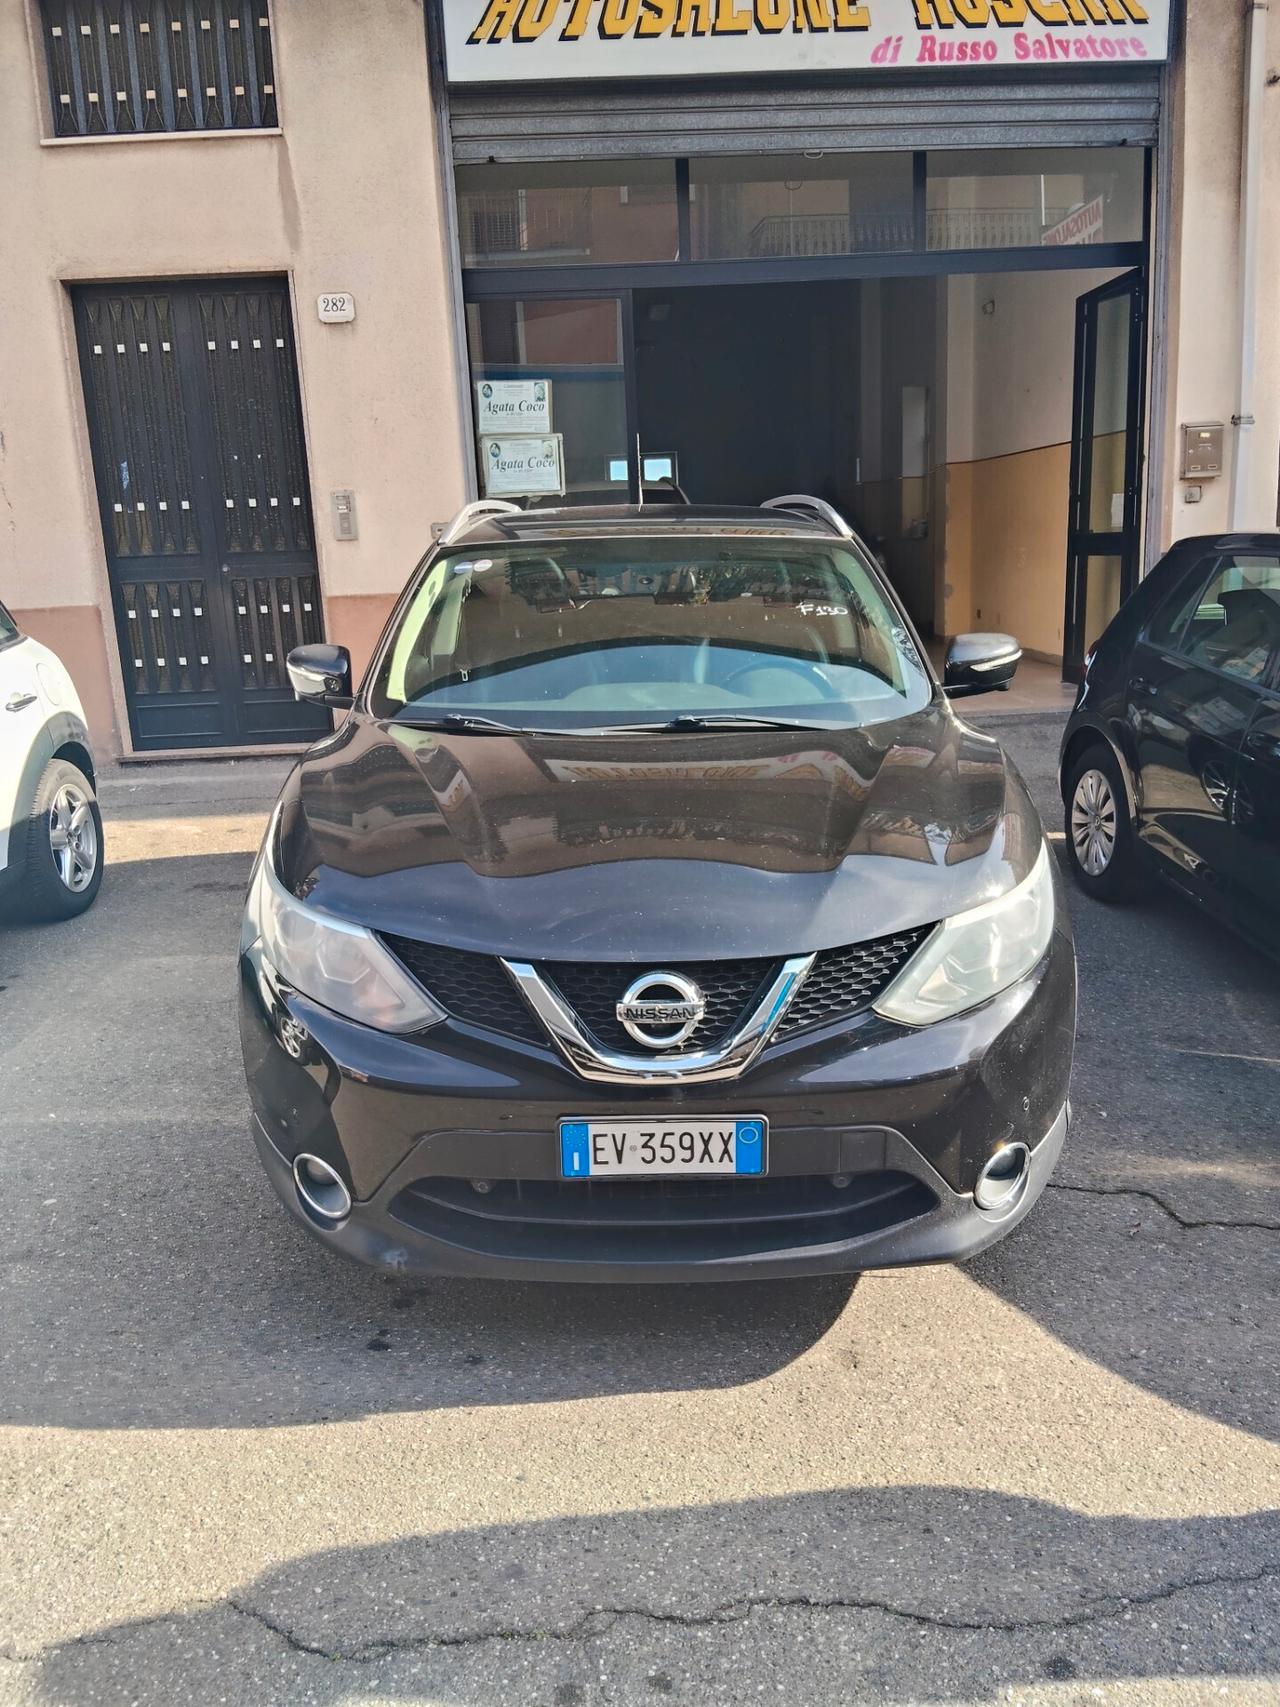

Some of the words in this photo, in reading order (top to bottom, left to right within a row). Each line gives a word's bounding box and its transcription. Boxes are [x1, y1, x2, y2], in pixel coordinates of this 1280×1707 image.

[870, 36, 904, 64] di
[916, 34, 998, 63] Russo
[1013, 32, 1148, 61] Salvatore
[322, 297, 346, 312] 282
[483, 401, 514, 415] Agata
[518, 400, 545, 412] Coco
[491, 459, 524, 472] Agata
[527, 457, 555, 469] Coco
[625, 1007, 697, 1019] NISSAN
[592, 1133, 627, 1165] EV
[640, 1131, 734, 1165] 359XX
